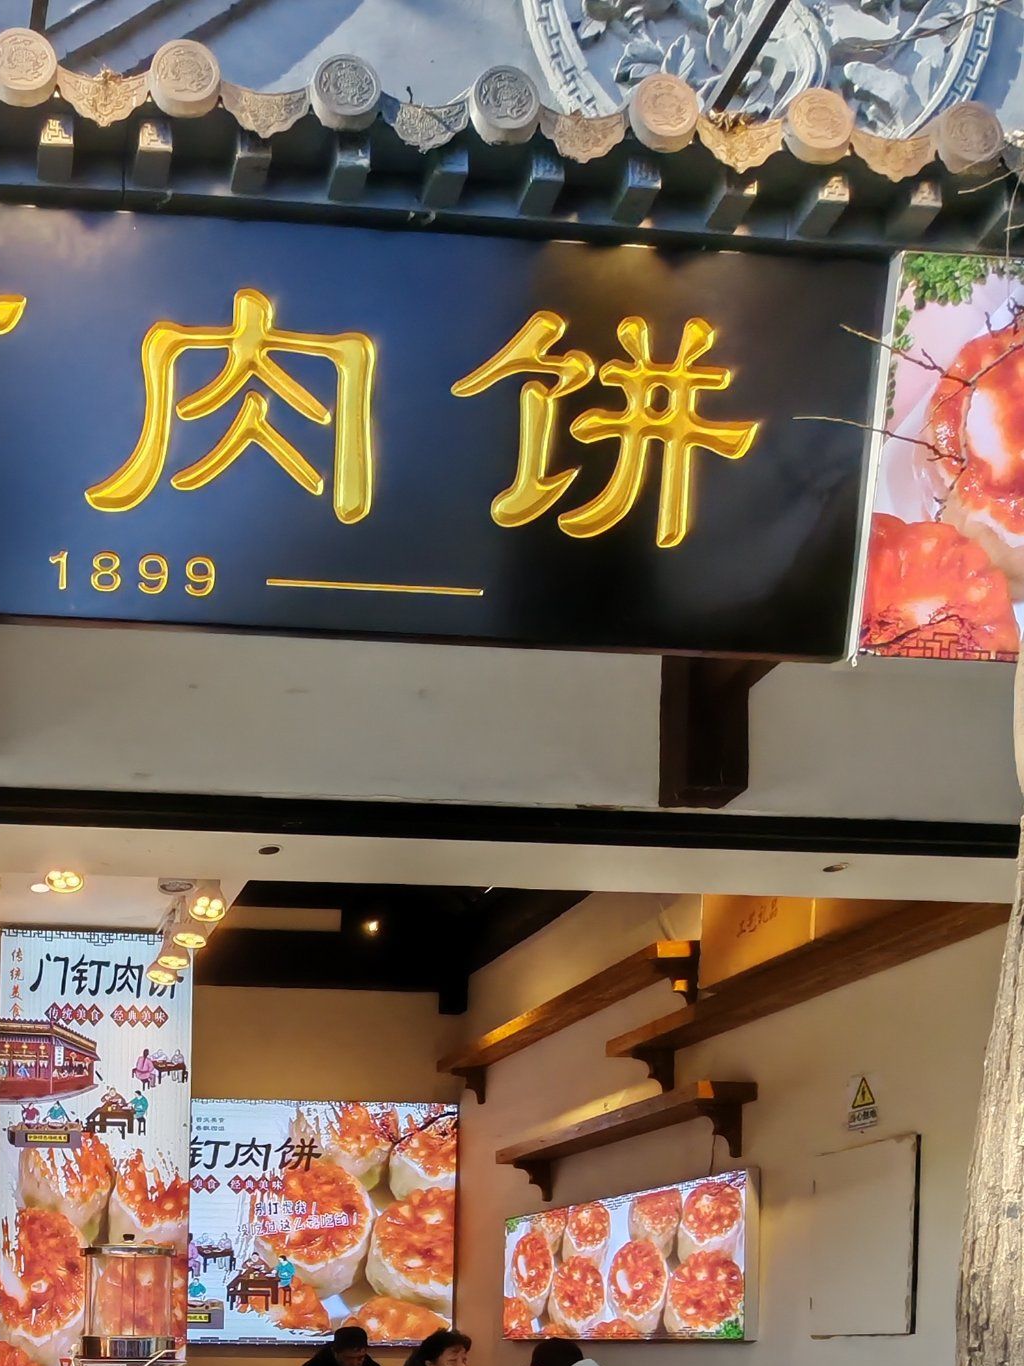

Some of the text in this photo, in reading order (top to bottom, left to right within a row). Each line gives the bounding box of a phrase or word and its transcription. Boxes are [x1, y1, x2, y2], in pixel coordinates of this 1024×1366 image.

[49, 549, 218, 598] 1899
[9, 947, 25, 1018] 传统美食
[48, 1006, 101, 1022] 传统美食
[113, 1008, 165, 1024] 经典美味
[230, 1179, 283, 1192] 经典美味
